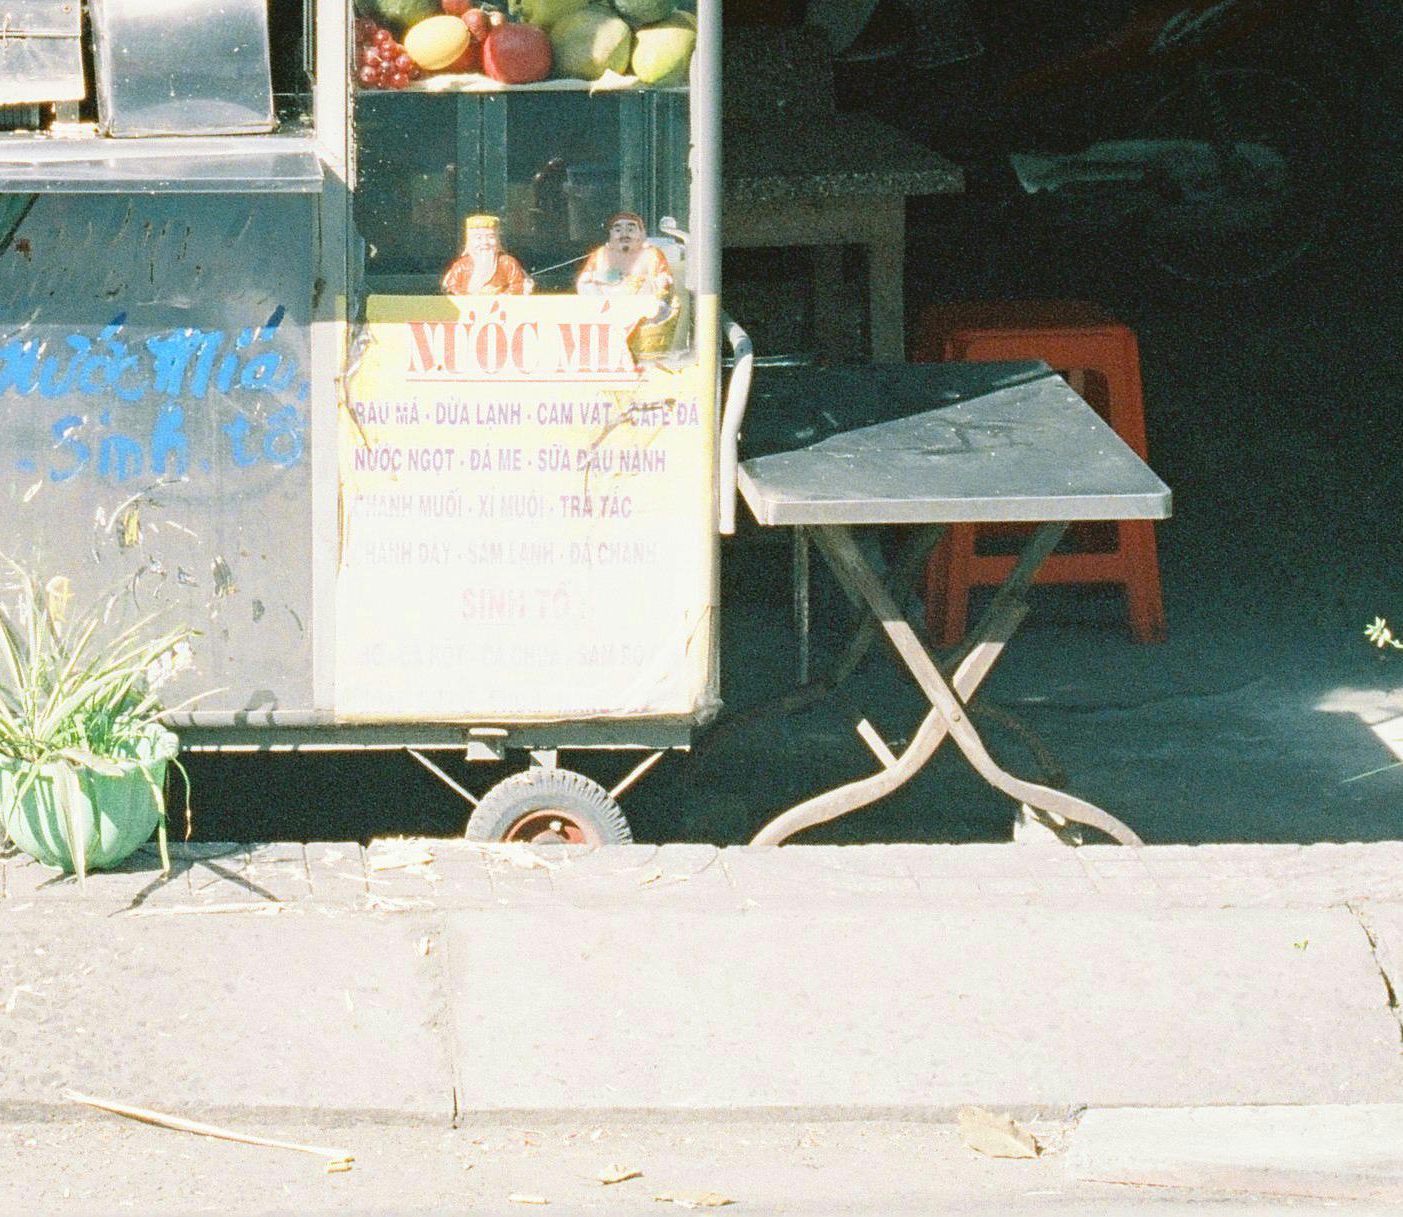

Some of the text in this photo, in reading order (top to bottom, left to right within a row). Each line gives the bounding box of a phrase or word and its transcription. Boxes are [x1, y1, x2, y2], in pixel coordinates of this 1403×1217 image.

[407, 299, 539, 374] NƯỚC
[355, 402, 389, 425] RAU
[537, 402, 573, 425] CAM
[354, 442, 402, 472] NƯỚC
[498, 448, 522, 471] ME
